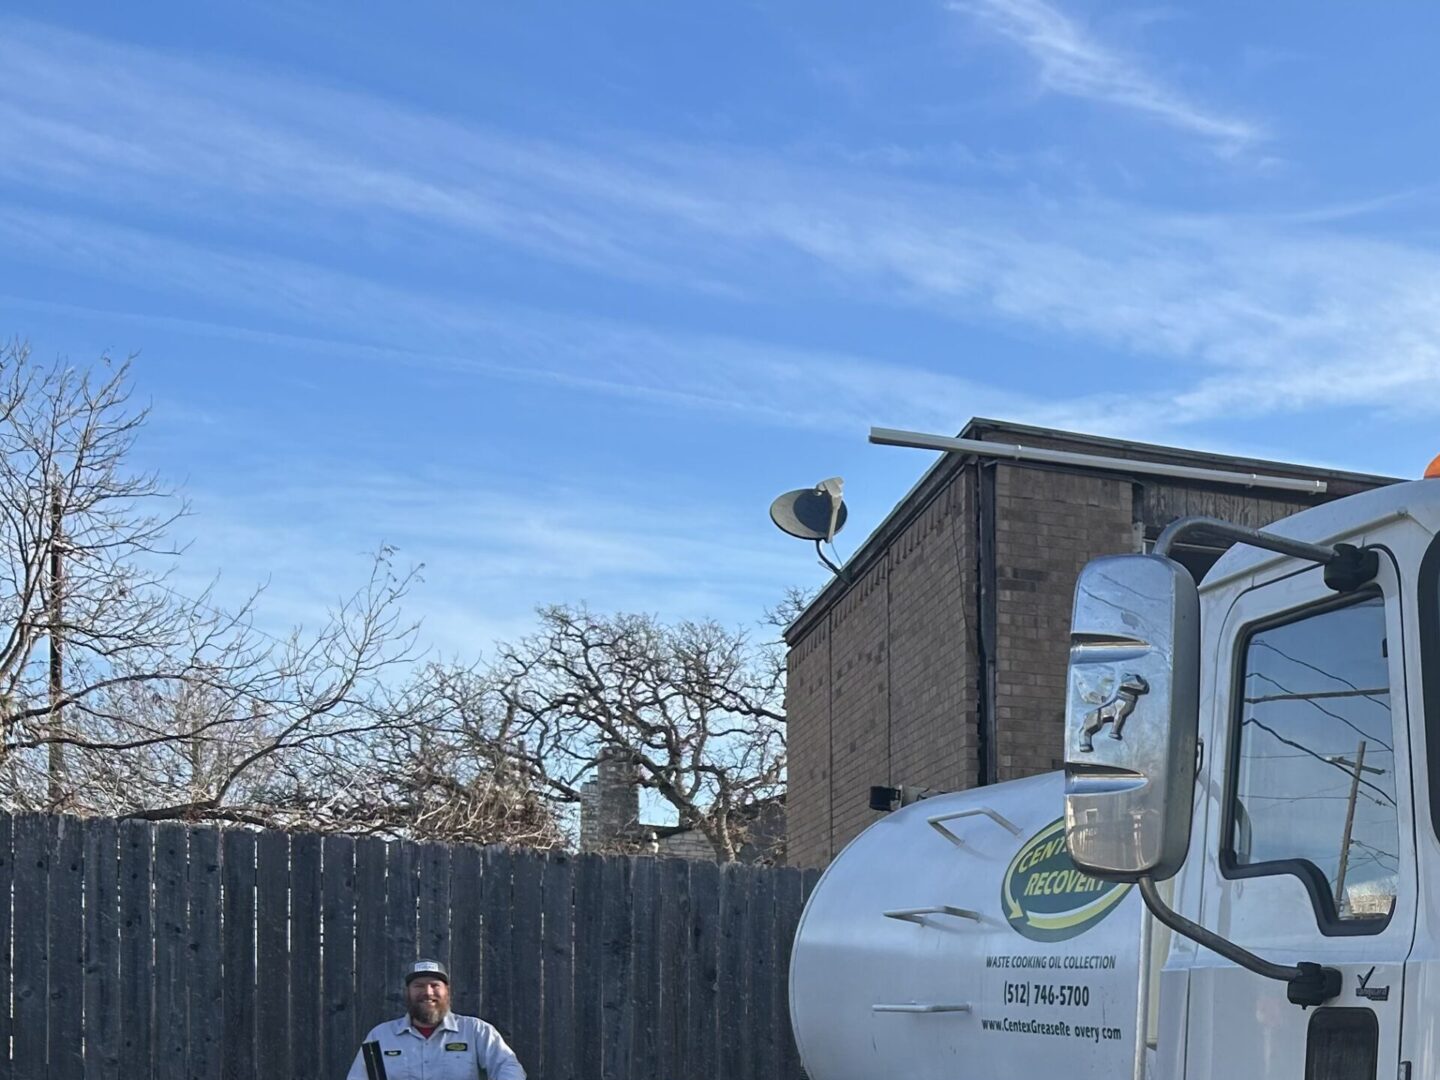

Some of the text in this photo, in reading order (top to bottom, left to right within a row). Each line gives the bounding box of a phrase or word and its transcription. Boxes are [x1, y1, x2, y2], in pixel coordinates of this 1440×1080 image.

[1018, 836, 1067, 873] CENT
[986, 955, 1117, 970] WASTE COOKING OIL COLLECTION
[1003, 980, 1090, 1007] (512) 746-5700
